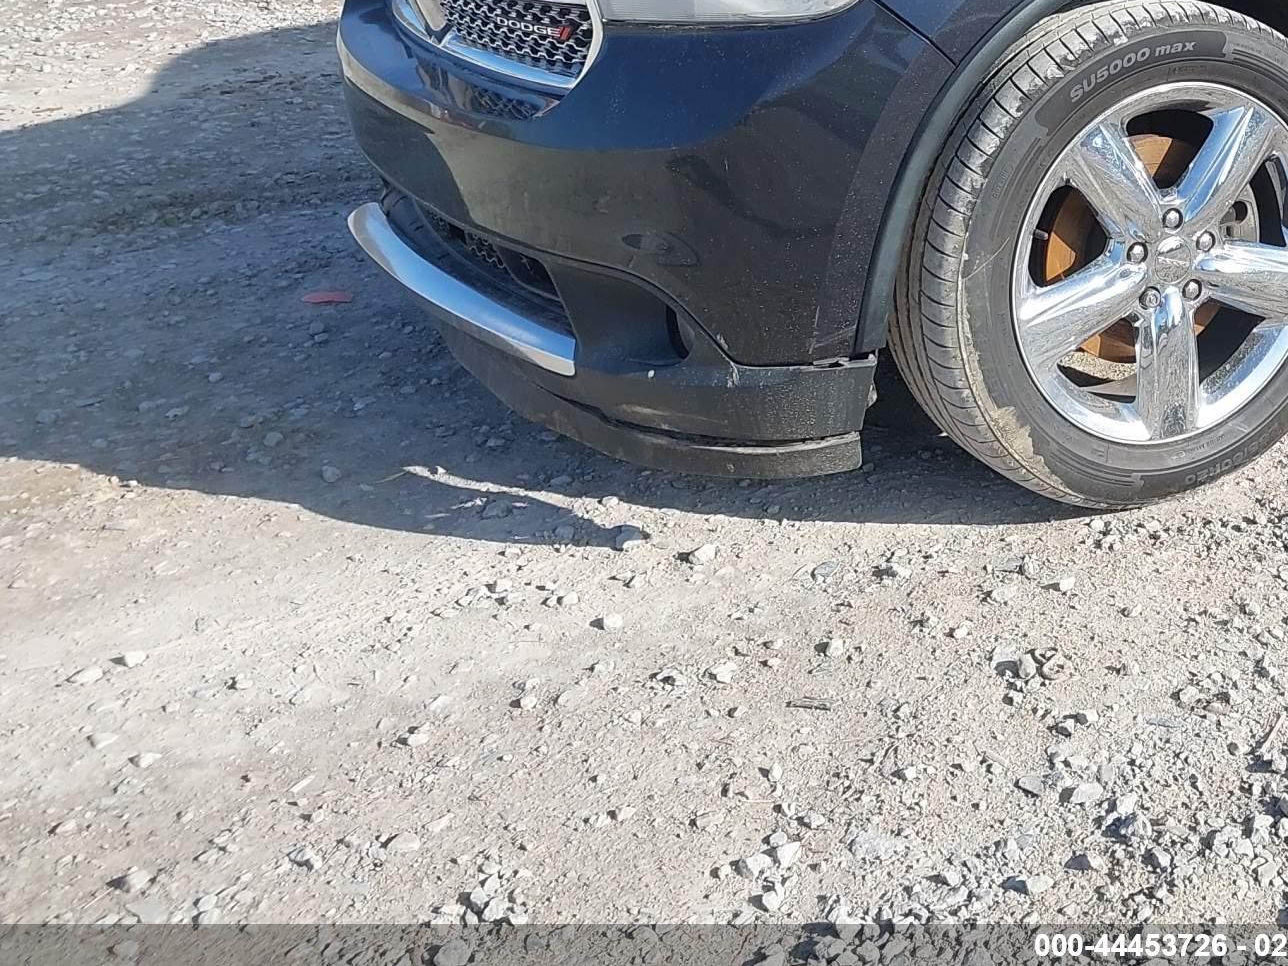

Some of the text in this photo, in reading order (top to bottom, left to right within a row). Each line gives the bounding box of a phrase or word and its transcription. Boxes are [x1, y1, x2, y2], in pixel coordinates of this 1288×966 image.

[497, 17, 561, 37] DODGE
[1070, 40, 1197, 103] SU5000 max
